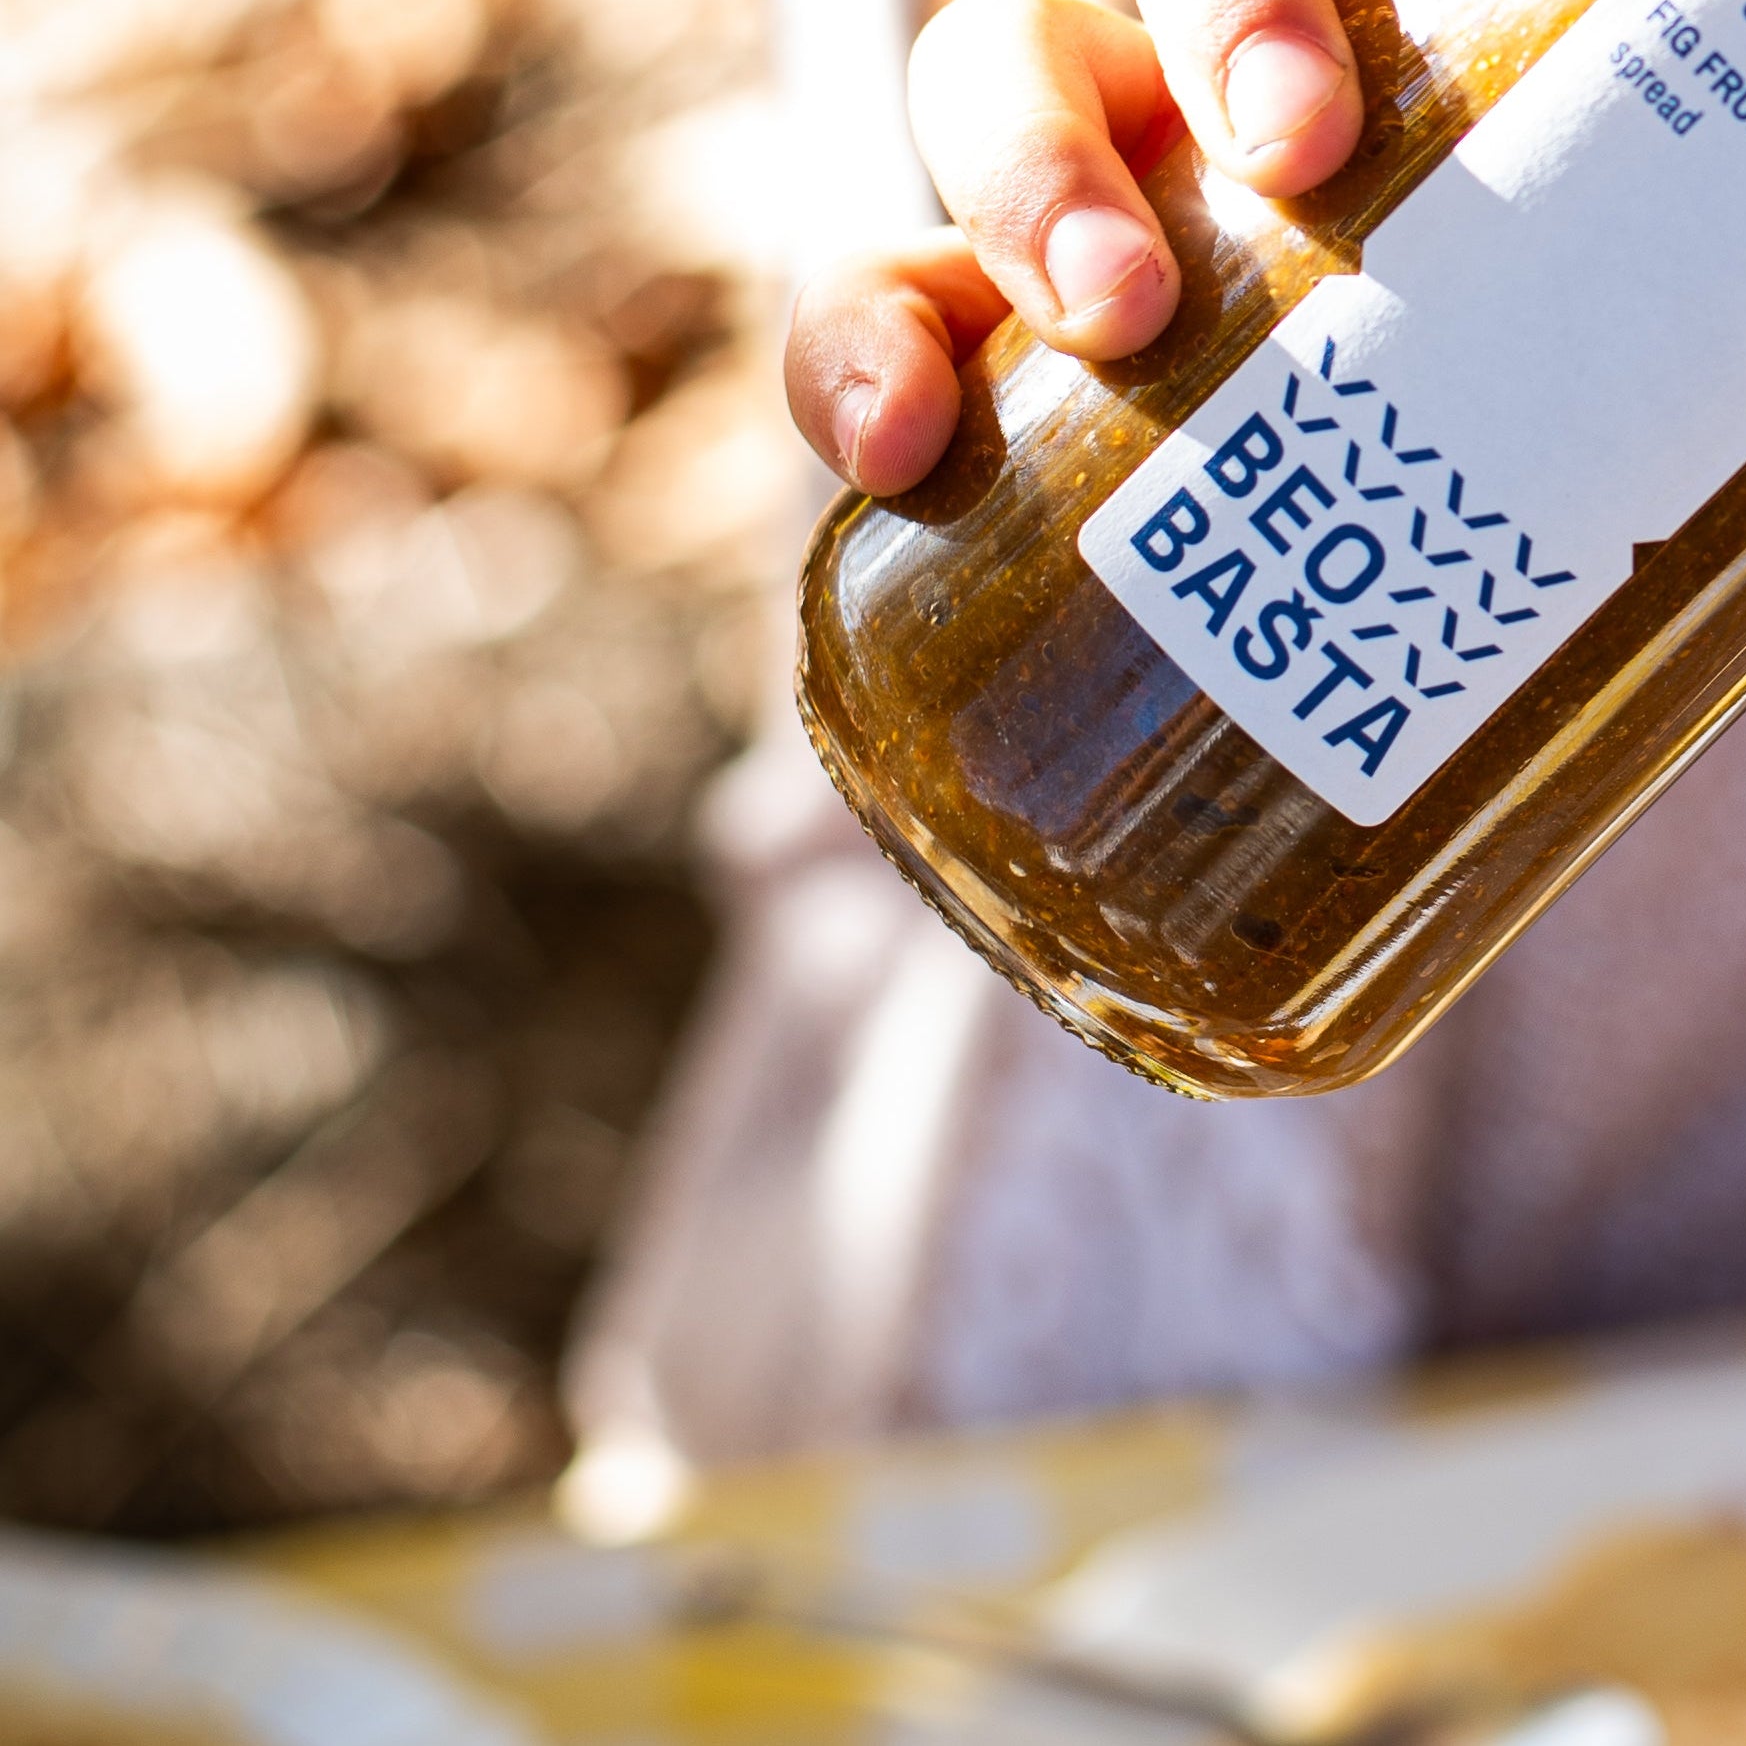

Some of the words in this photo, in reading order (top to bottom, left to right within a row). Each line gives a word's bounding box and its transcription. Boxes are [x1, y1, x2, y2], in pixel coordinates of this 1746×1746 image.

[1610, 41, 1704, 137] spread
[1646, 0, 1701, 60] FIG
[1203, 411, 1386, 605] BEO
[1130, 486, 1412, 778] BAŠTA
